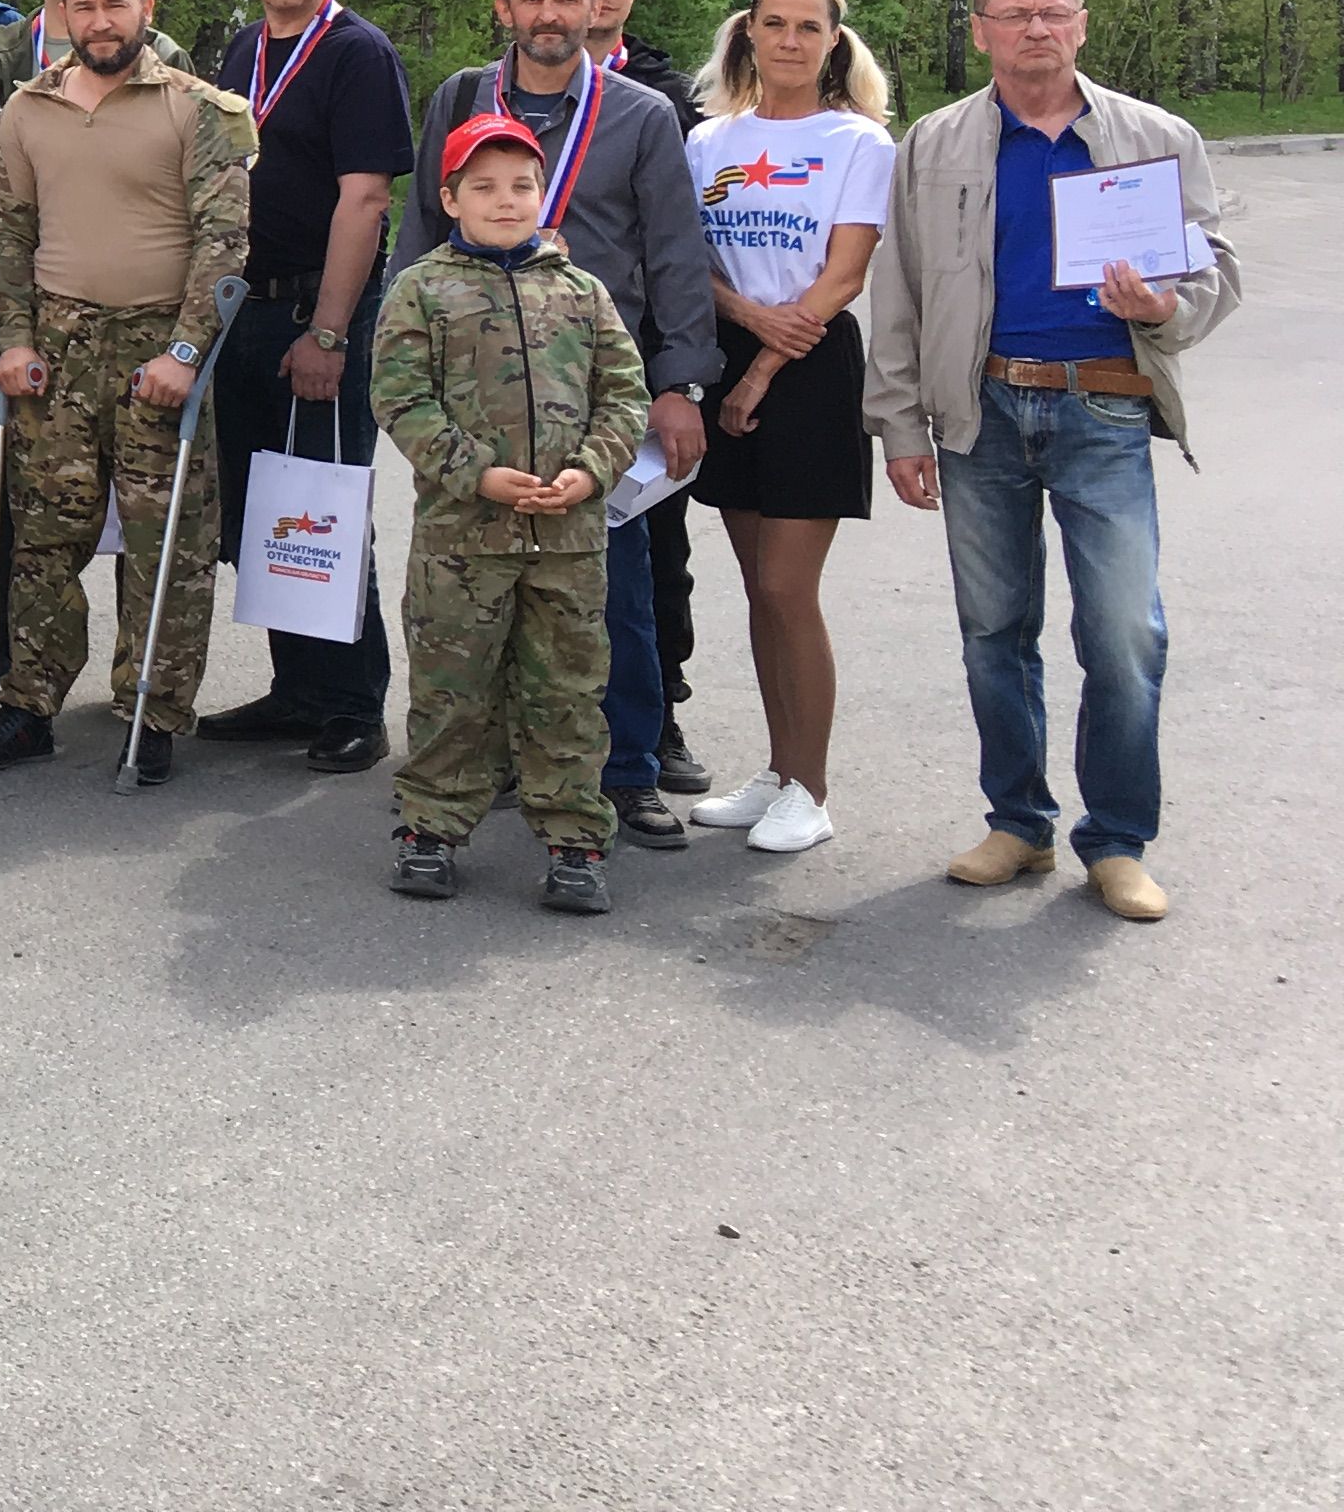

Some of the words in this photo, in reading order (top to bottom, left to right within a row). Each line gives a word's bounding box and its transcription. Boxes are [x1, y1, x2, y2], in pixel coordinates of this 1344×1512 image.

[700, 209, 819, 235] ЗАЩИТНИКИ
[704, 230, 804, 253] ОТЕЧЕСТВА
[264, 539, 342, 560] ЗАЩИТНИКИ
[267, 550, 335, 570] ОТЕЧЕСТВА
